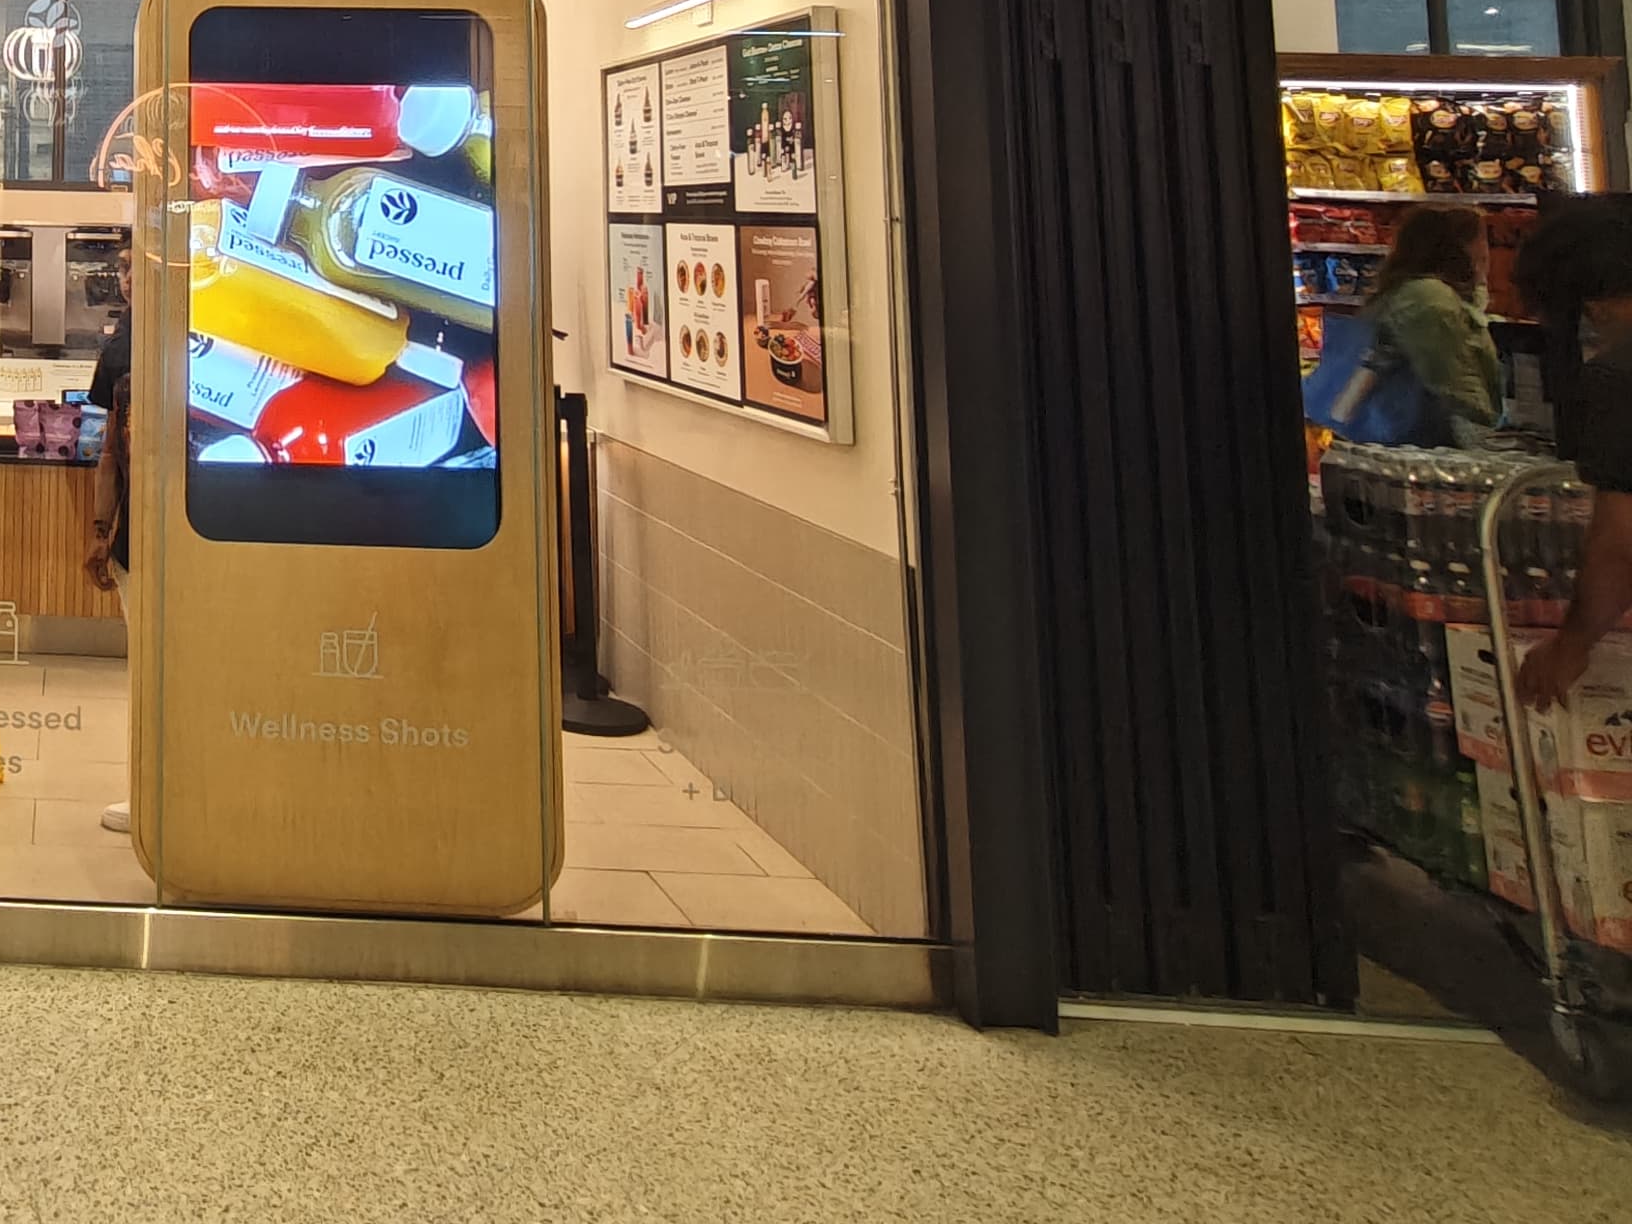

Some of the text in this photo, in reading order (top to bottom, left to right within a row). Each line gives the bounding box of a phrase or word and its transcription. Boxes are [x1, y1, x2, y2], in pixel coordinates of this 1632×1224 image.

[368, 239, 465, 281] pressed
[191, 380, 234, 408] pres
[229, 710, 469, 748] Wellness Shots
